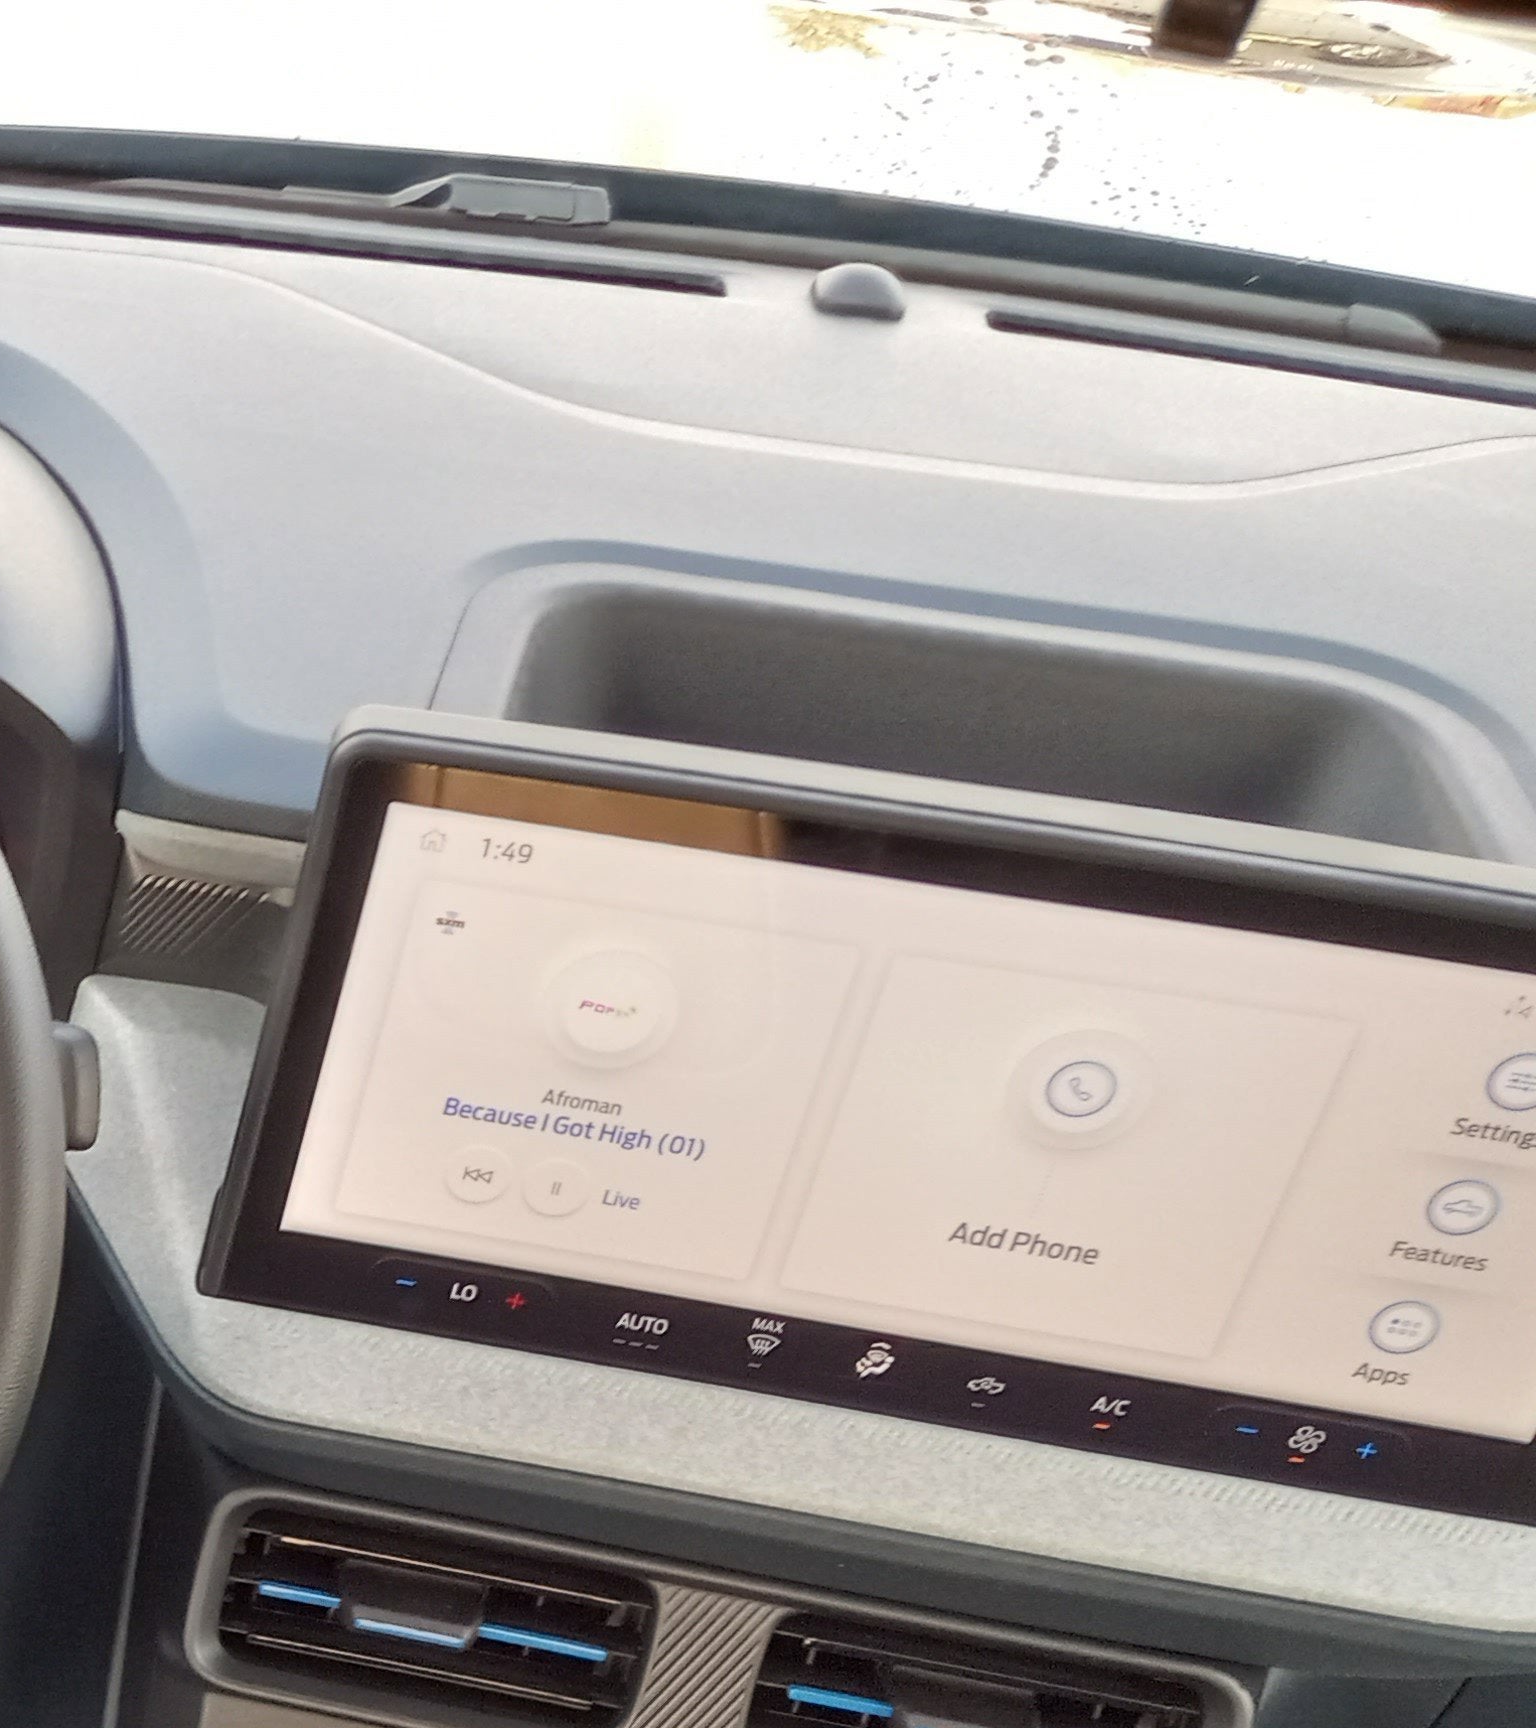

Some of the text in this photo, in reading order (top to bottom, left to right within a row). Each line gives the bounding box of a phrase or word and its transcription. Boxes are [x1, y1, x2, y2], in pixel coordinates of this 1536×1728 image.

[481, 837, 534, 865] 1:49
[435, 917, 465, 929] sxm
[542, 1088, 622, 1116] Afroman
[442, 1097, 538, 1131] Because
[552, 1115, 595, 1141] Got
[598, 1122, 652, 1151] High
[602, 1189, 640, 1210] Live
[948, 1222, 1100, 1266] Add Phone
[1389, 1240, 1489, 1272] Features
[449, 1282, 478, 1302] LO
[615, 1312, 670, 1335] AUTO
[751, 1317, 786, 1334] MAX
[1352, 1363, 1410, 1387] Apps
[1091, 1396, 1131, 1417] A/C
